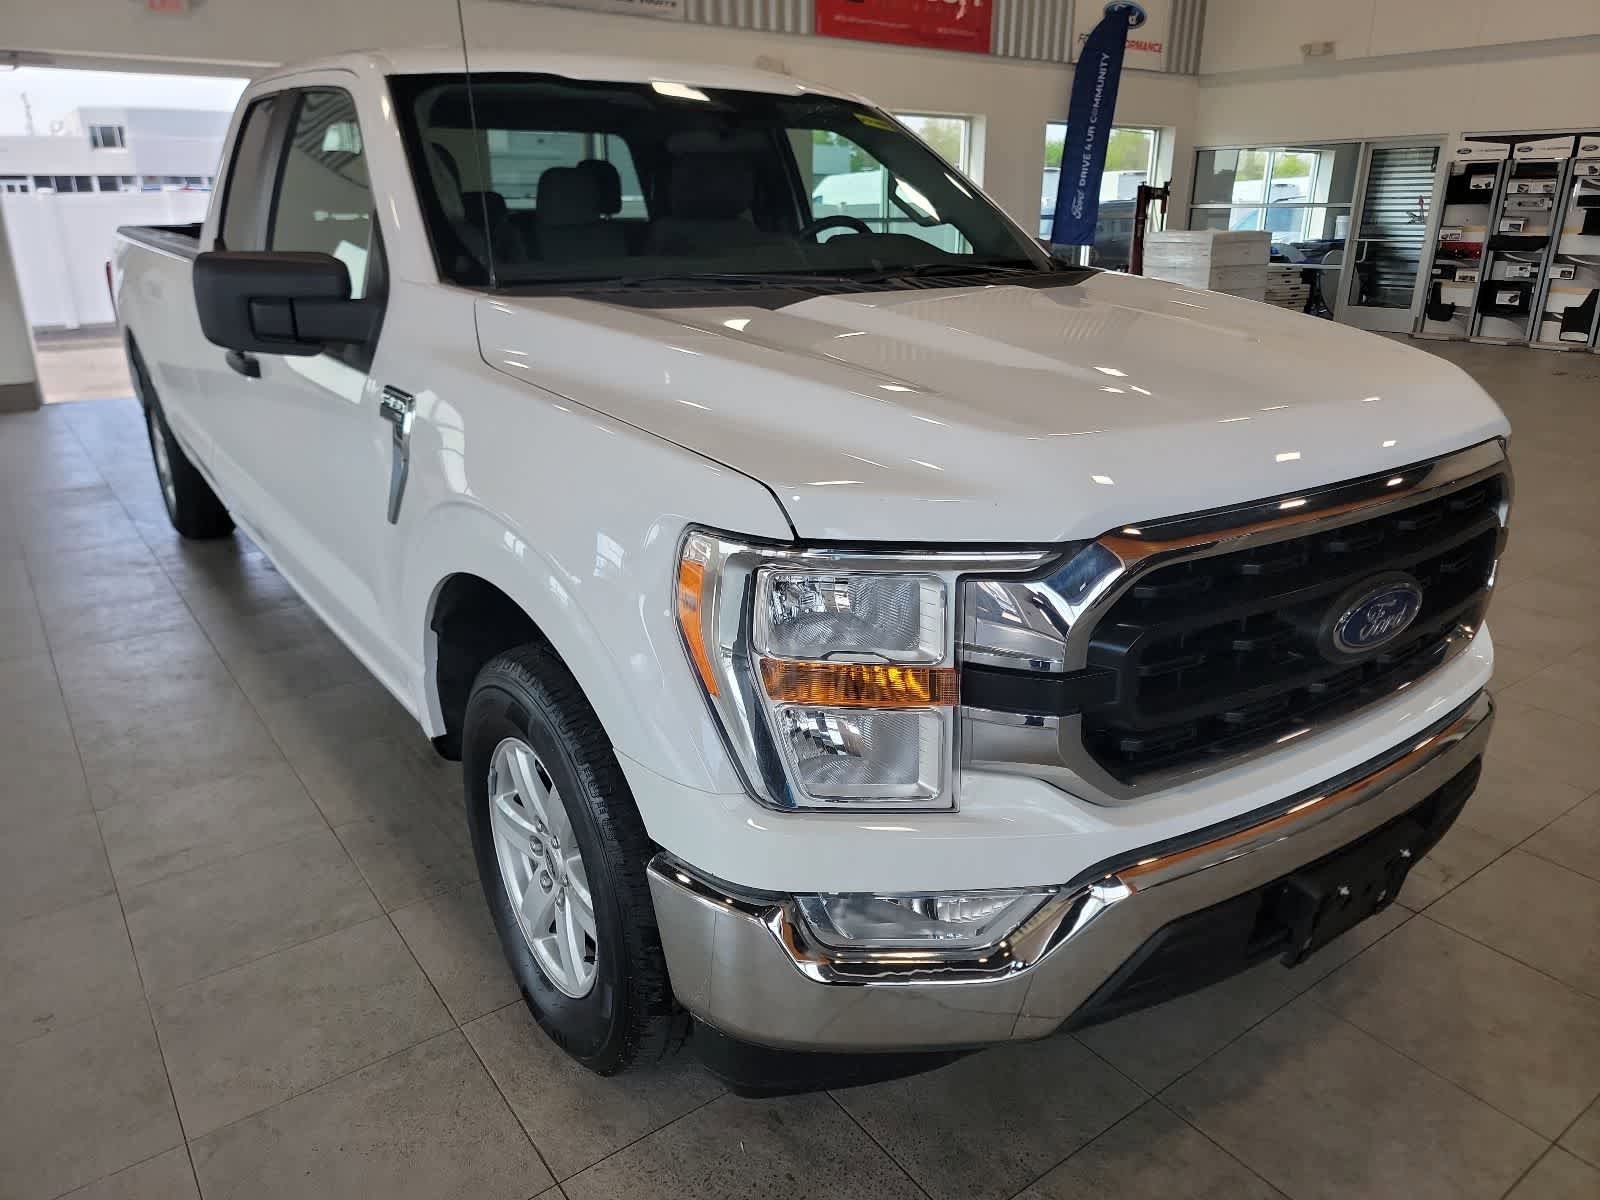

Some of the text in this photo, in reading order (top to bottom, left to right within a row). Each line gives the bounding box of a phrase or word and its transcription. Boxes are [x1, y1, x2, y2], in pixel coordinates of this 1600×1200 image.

[1071, 190, 1085, 219] Ford
[1079, 153, 1091, 187] DRIVE
[1089, 51, 1110, 123] COMMUNITY
